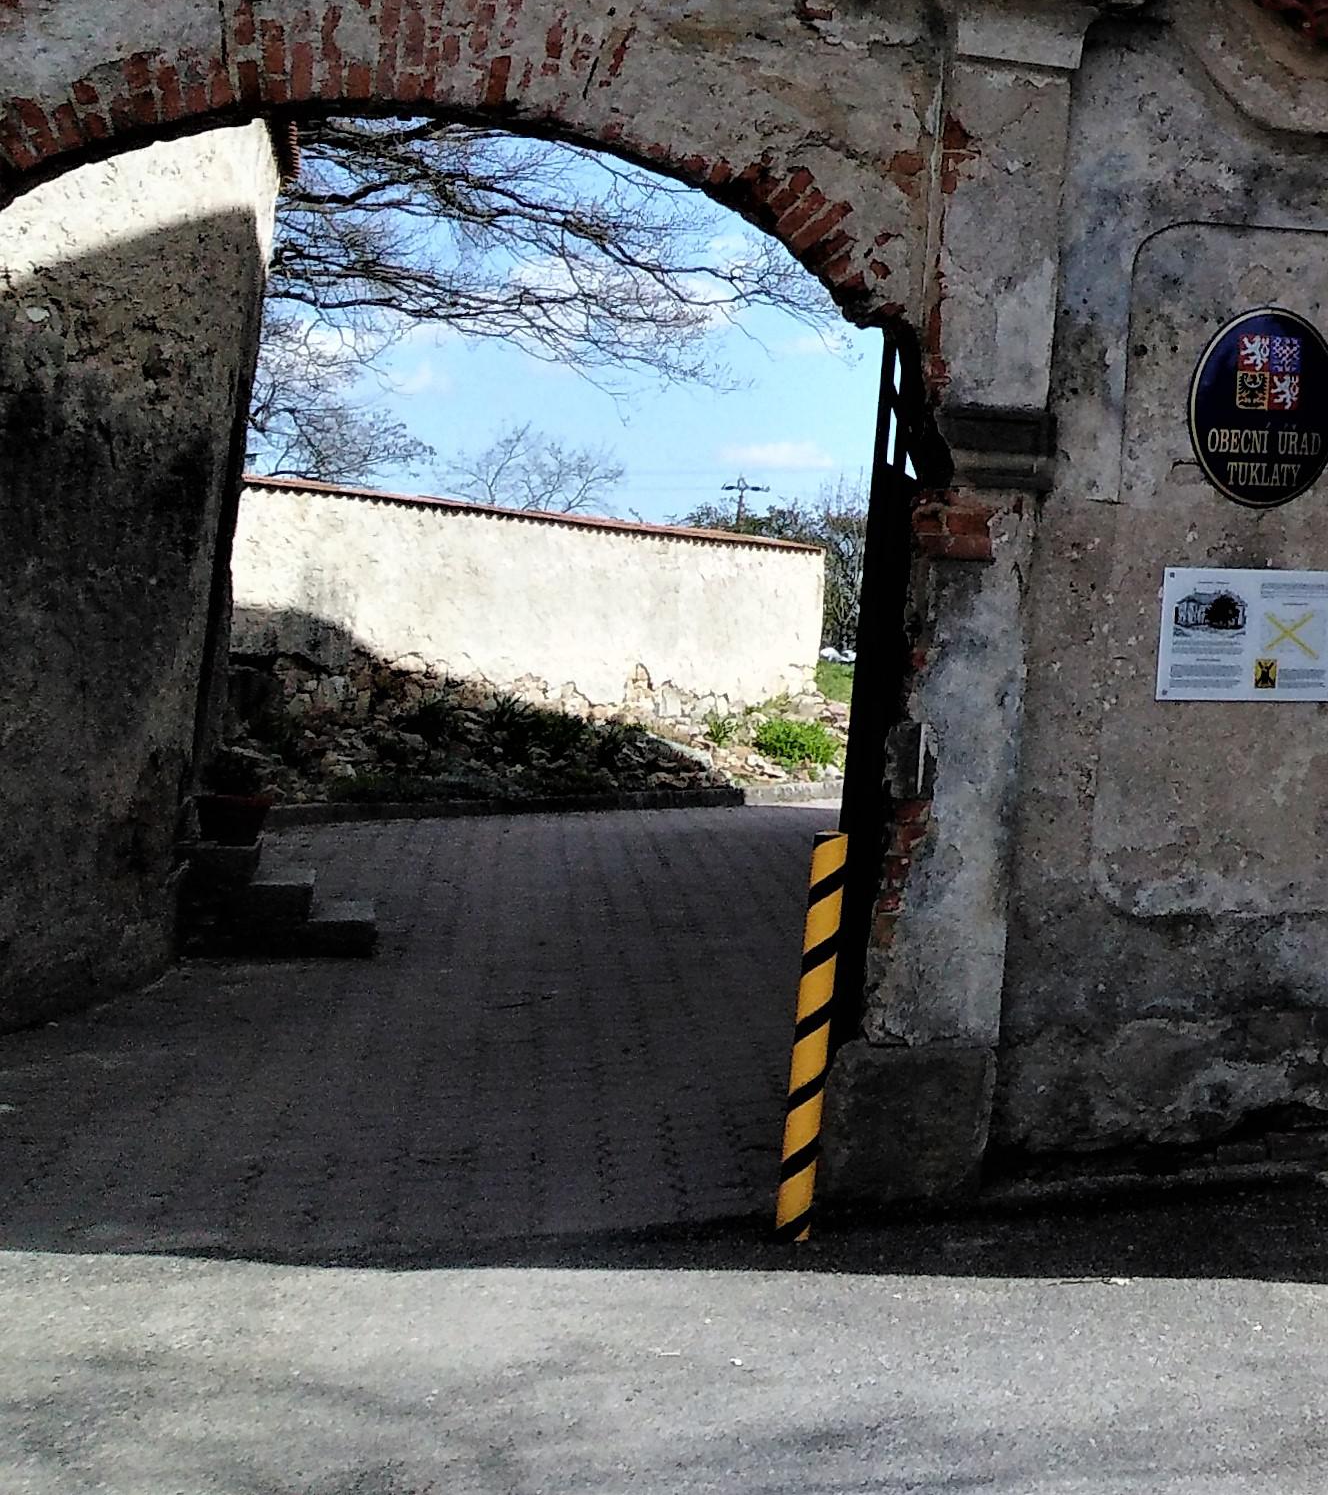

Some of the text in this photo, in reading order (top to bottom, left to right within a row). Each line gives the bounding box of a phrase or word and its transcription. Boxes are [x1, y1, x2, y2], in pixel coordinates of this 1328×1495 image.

[1207, 422, 1321, 455] OBECNÍ ÚŘAD
[1227, 462, 1301, 487] TUKLATY
